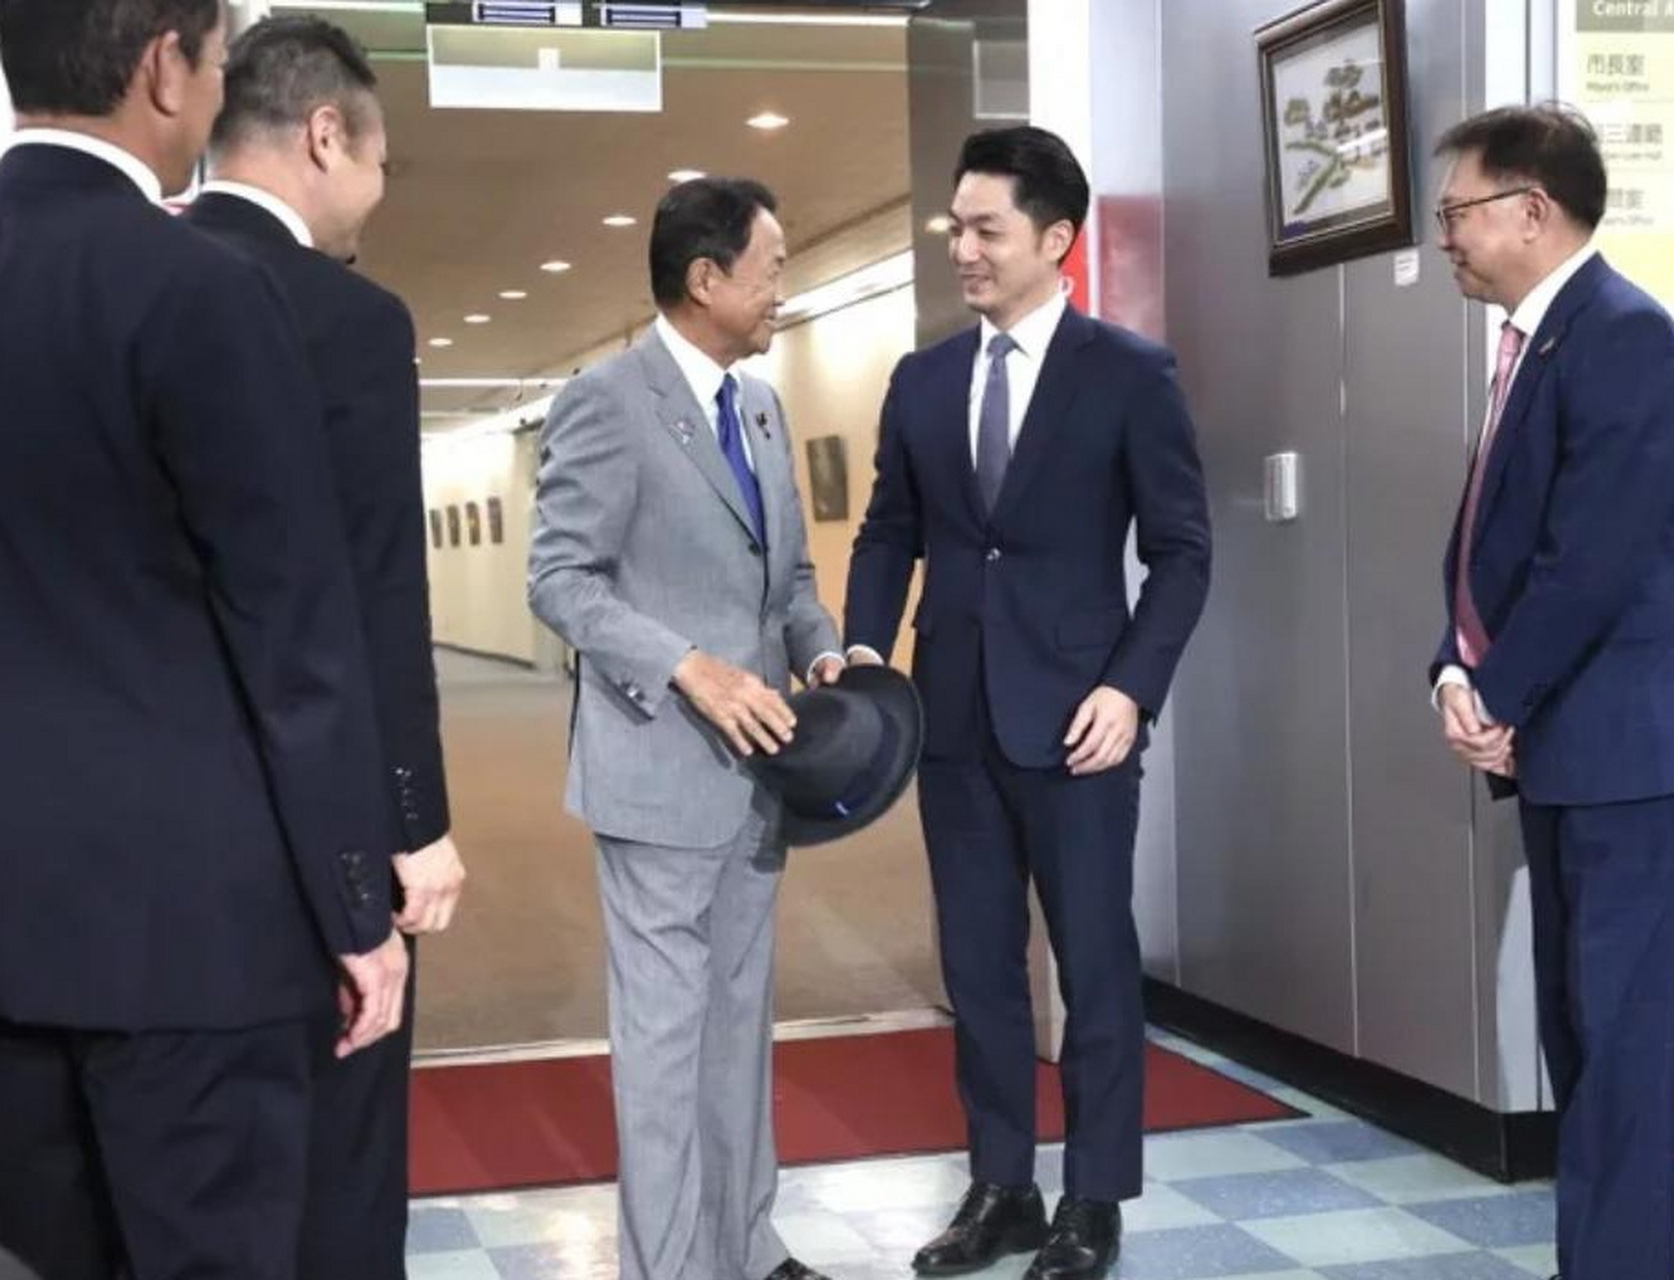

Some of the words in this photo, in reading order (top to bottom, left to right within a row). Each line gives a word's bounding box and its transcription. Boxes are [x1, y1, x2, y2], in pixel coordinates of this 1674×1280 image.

[1593, 0, 1658, 16] Central
[1587, 54, 1645, 76] 市長室
